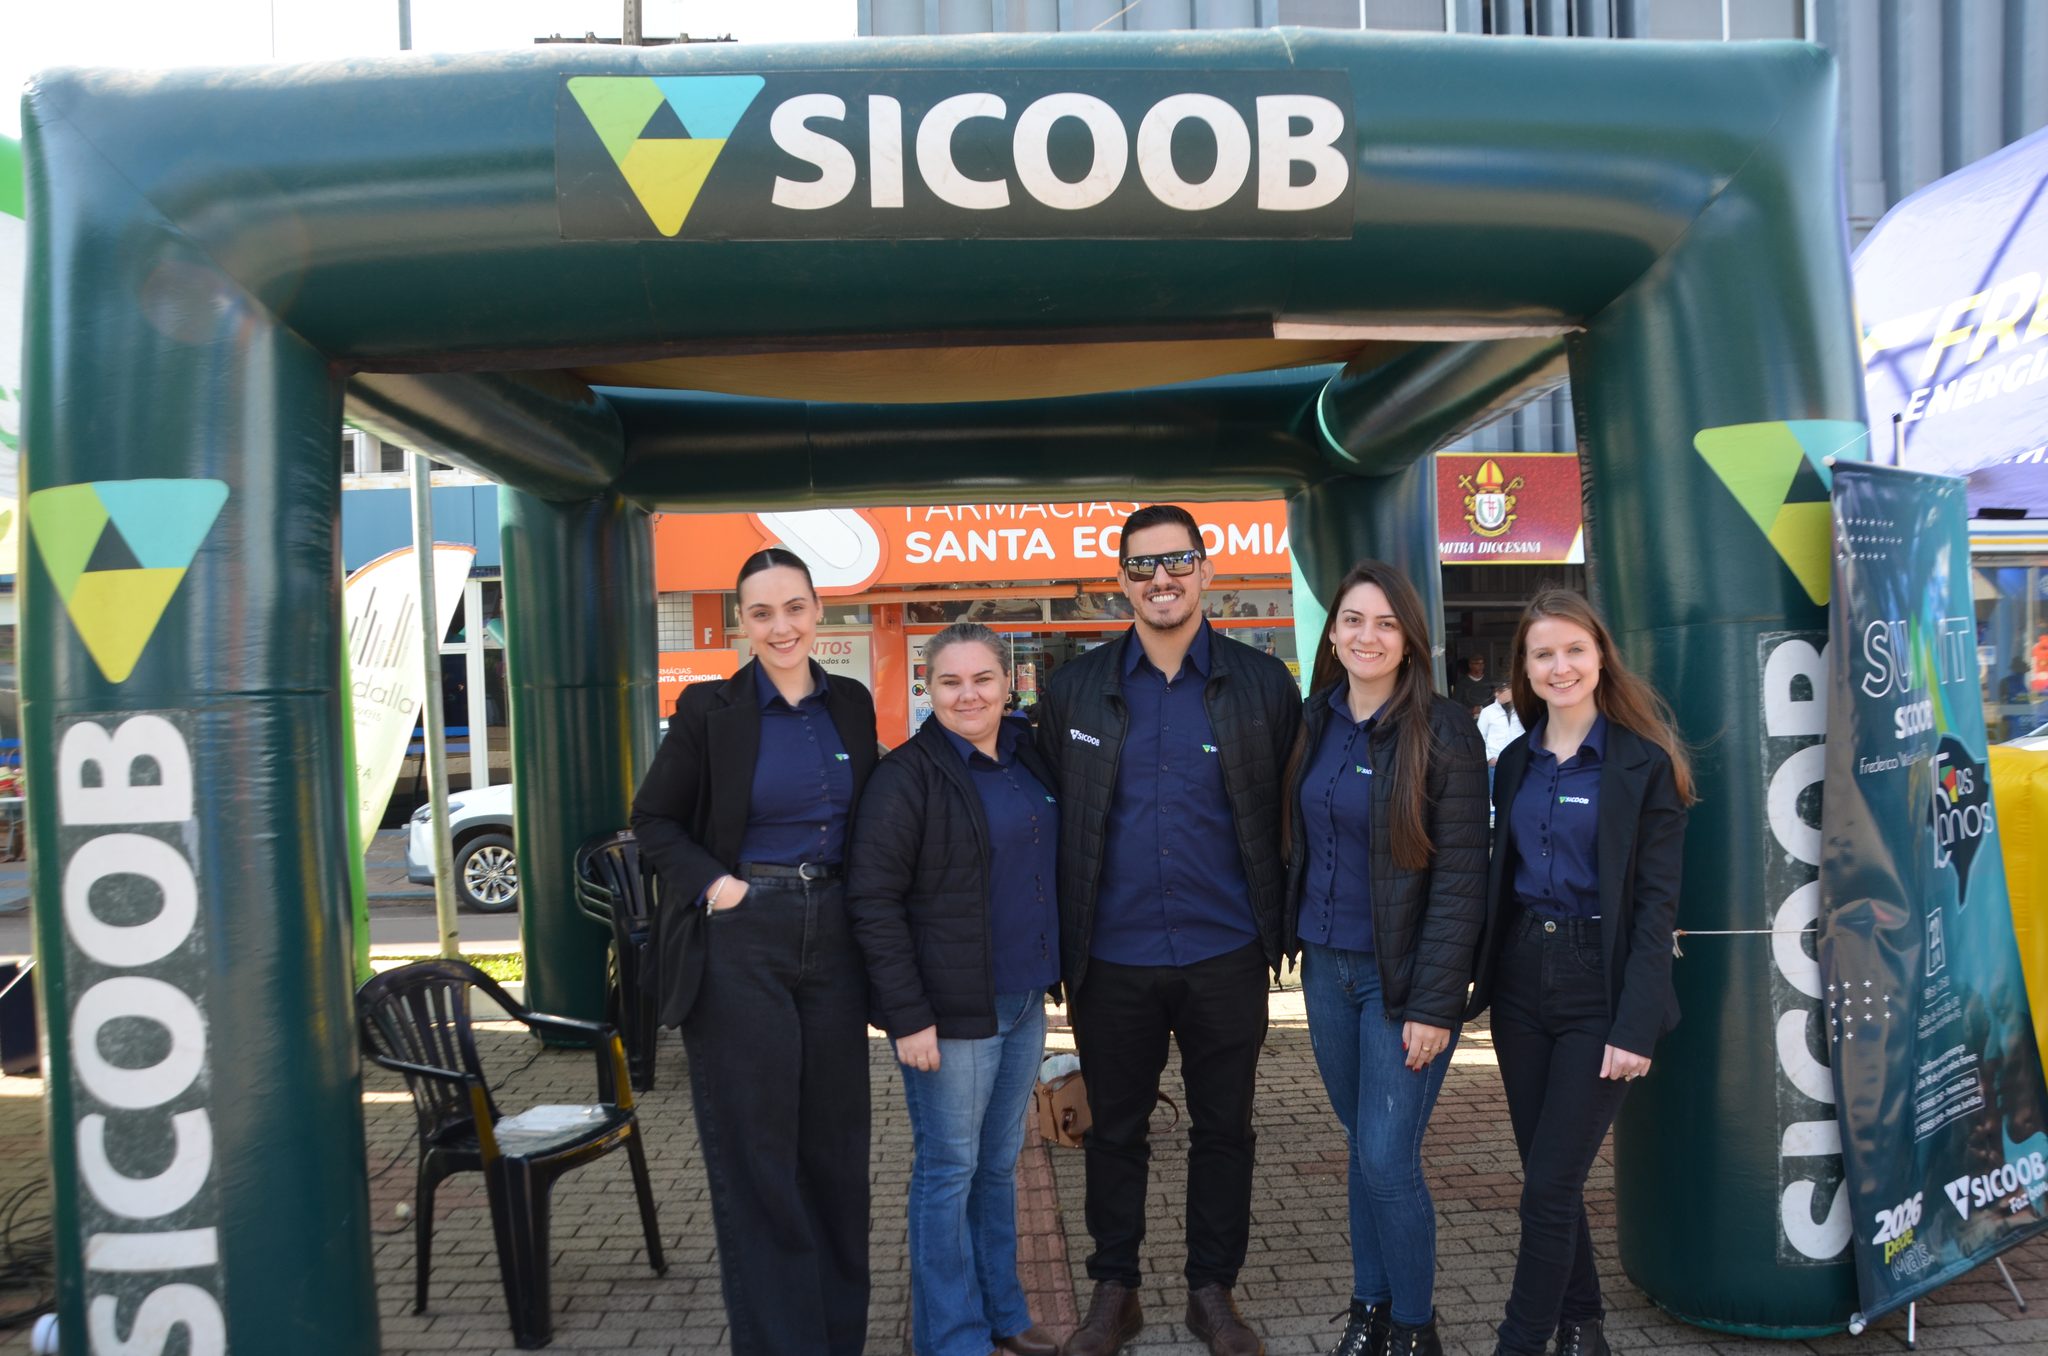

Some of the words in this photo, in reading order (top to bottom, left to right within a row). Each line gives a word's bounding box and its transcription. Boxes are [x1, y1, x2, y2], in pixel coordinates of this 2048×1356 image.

[769, 92, 1349, 211] SICOOB
[905, 527, 1056, 564] SANTA
[1073, 522, 1291, 559] ECOMI
[1438, 541, 1475, 554] MITRA
[1477, 541, 1542, 554] DIOCESANA
[351, 674, 415, 716] dalla
[678, 674, 722, 682] ECONOMIA
[1077, 732, 1100, 747] SICOOB
[57, 714, 228, 1356] SICOOB
[1970, 1151, 2046, 1208] SICOOB
[1872, 1191, 1923, 1245] 2026
